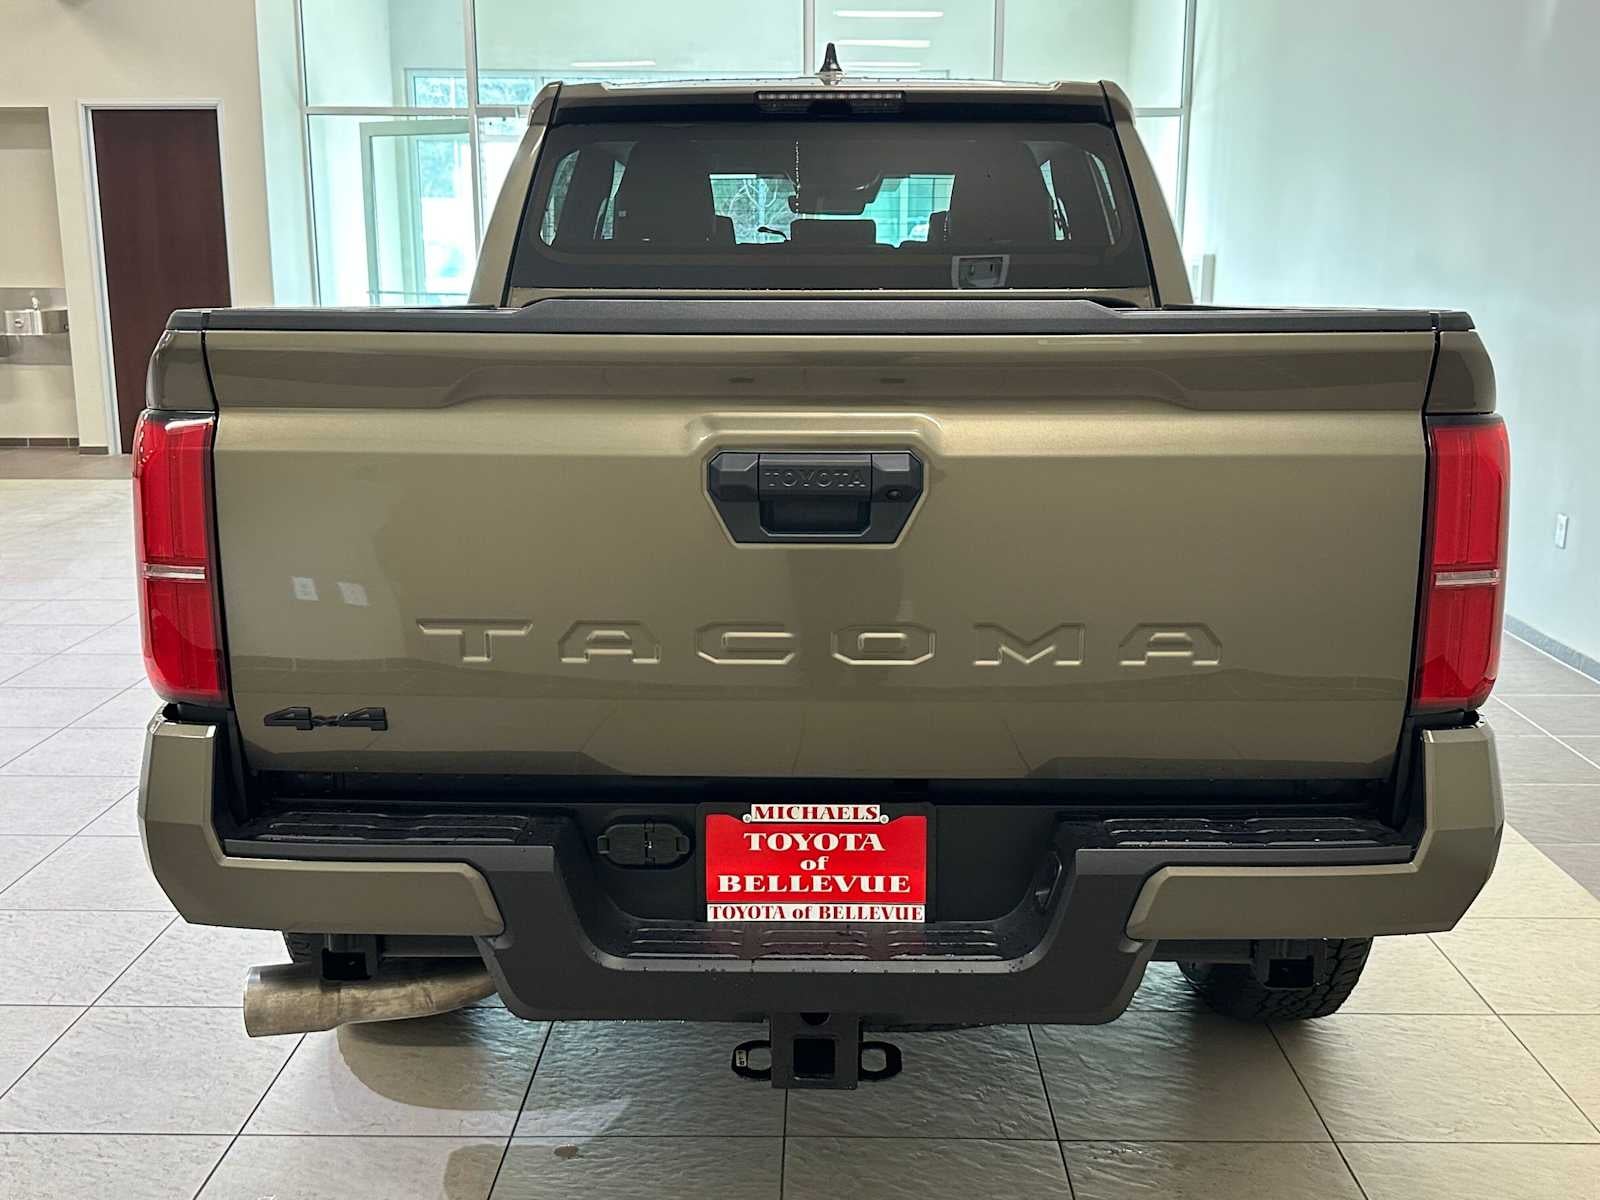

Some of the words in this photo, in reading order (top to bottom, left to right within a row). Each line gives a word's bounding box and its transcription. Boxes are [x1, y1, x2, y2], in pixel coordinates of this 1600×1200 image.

[764, 470, 866, 488] TOYOTA
[416, 618, 1223, 667] TACOMA
[754, 805, 879, 821] MICHAELS
[743, 832, 886, 852] TOYOTA
[800, 856, 830, 871] of
[717, 874, 912, 893] BELLEVUE
[709, 905, 786, 920] TOYOTA
[792, 905, 813, 920] of
[819, 905, 924, 921] BELLEVUE
